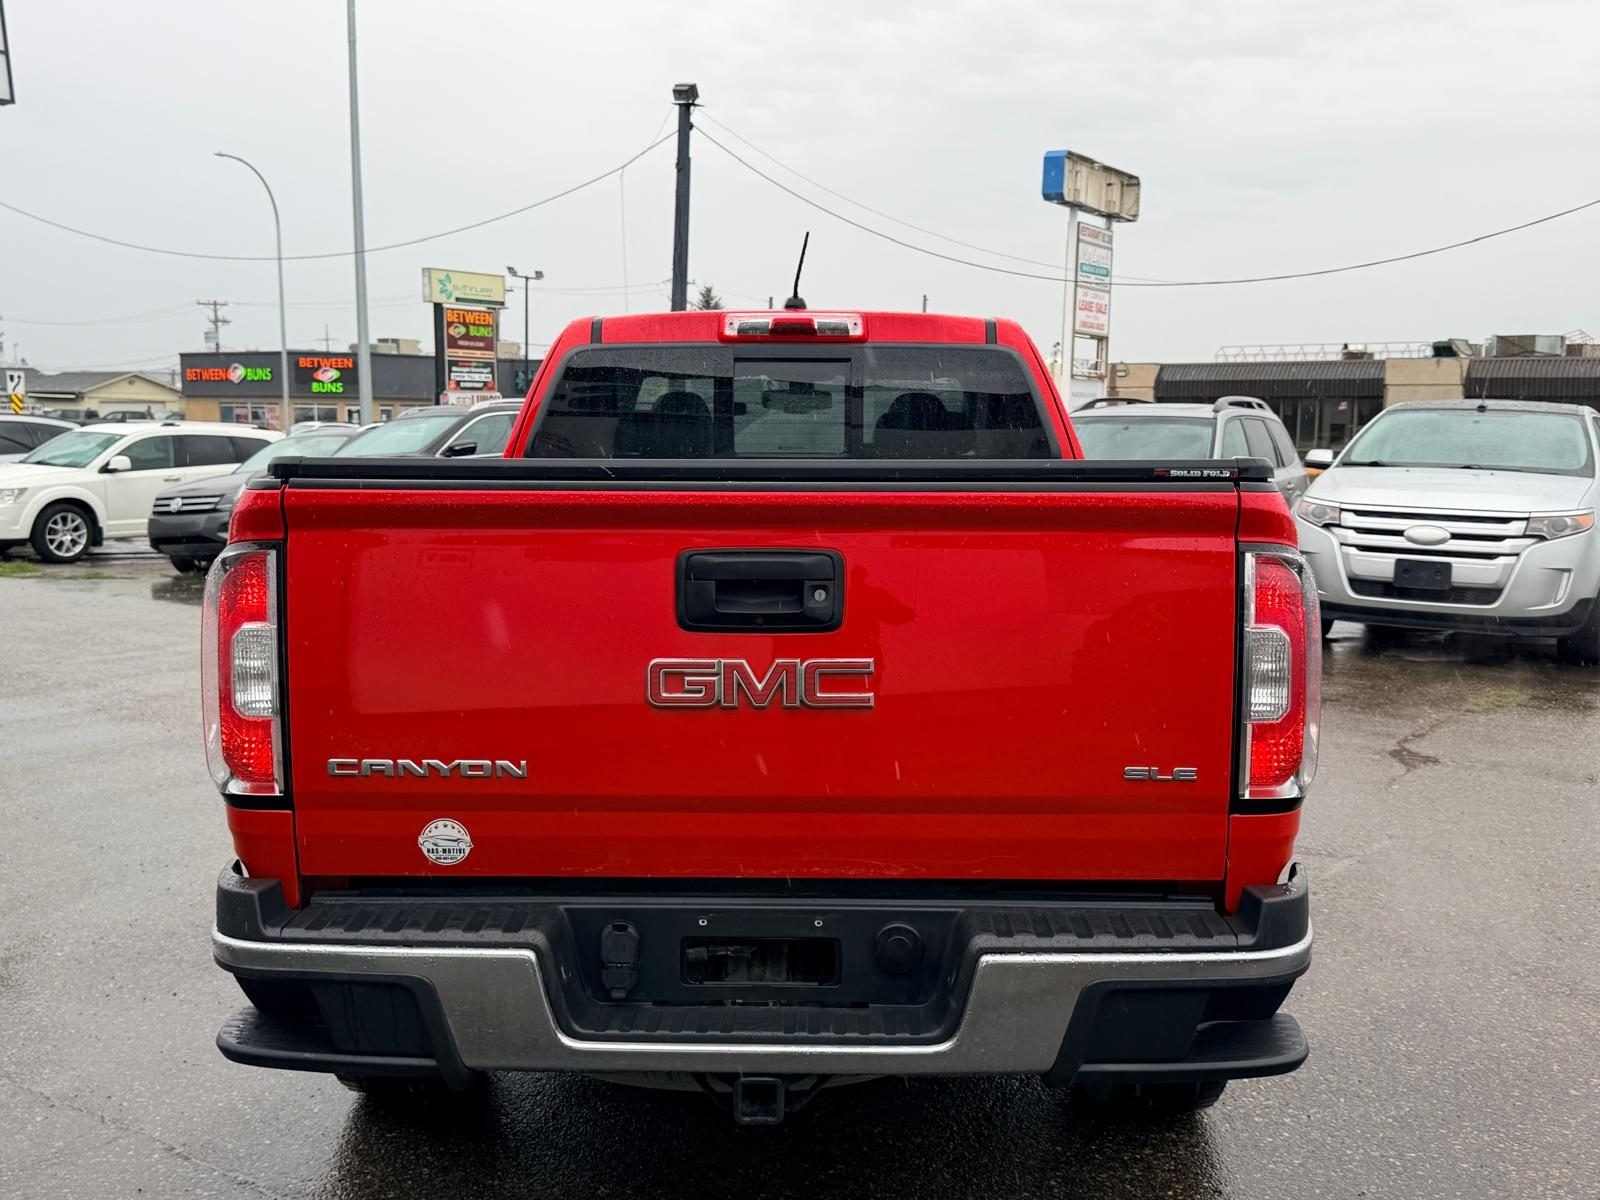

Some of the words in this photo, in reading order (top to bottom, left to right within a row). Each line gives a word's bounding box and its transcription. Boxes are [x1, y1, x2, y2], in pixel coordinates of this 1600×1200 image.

[447, 309, 493, 325] BETWEEN
[469, 325, 493, 337] BUNS
[299, 357, 353, 368] BETWEEN
[186, 368, 227, 381] BETWEEN
[247, 368, 272, 380] BUNS
[311, 382, 344, 393] BUNS
[647, 657, 875, 708] GMC
[327, 758, 528, 778] CANYON
[1124, 766, 1198, 780] SLE
